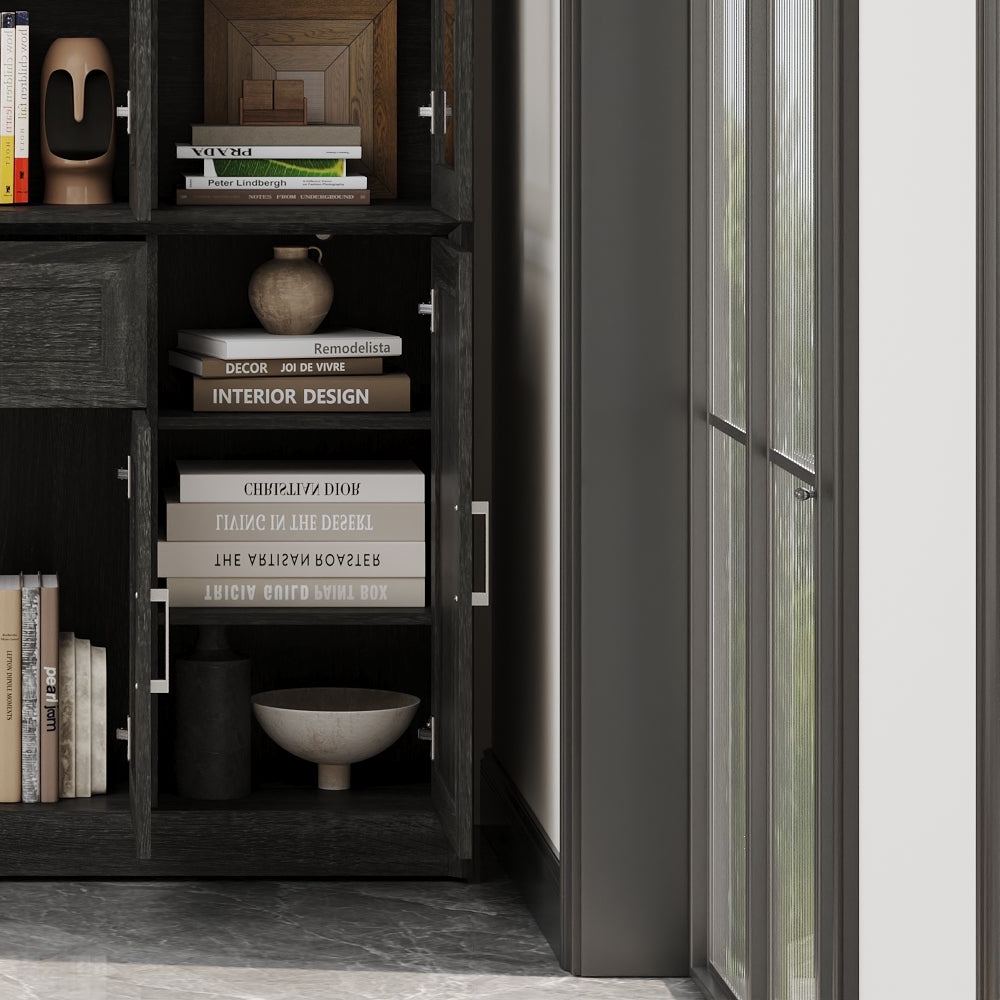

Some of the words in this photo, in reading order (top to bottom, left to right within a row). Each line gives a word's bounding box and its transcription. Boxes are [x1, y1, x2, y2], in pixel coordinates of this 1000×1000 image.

[192, 148, 252, 157] PRADA
[208, 179, 233, 187] Peter
[236, 179, 287, 188] Lindbergh
[314, 342, 391, 354] Remodelista
[225, 363, 268, 374] DECOR
[281, 363, 297, 373] JOI
[300, 363, 313, 372] DE
[316, 362, 346, 372] VIVRE
[213, 389, 297, 405] INTERIOR
[303, 389, 369, 405] DESIGN
[44, 666, 58, 702] pearl
[44, 705, 57, 732] jam
